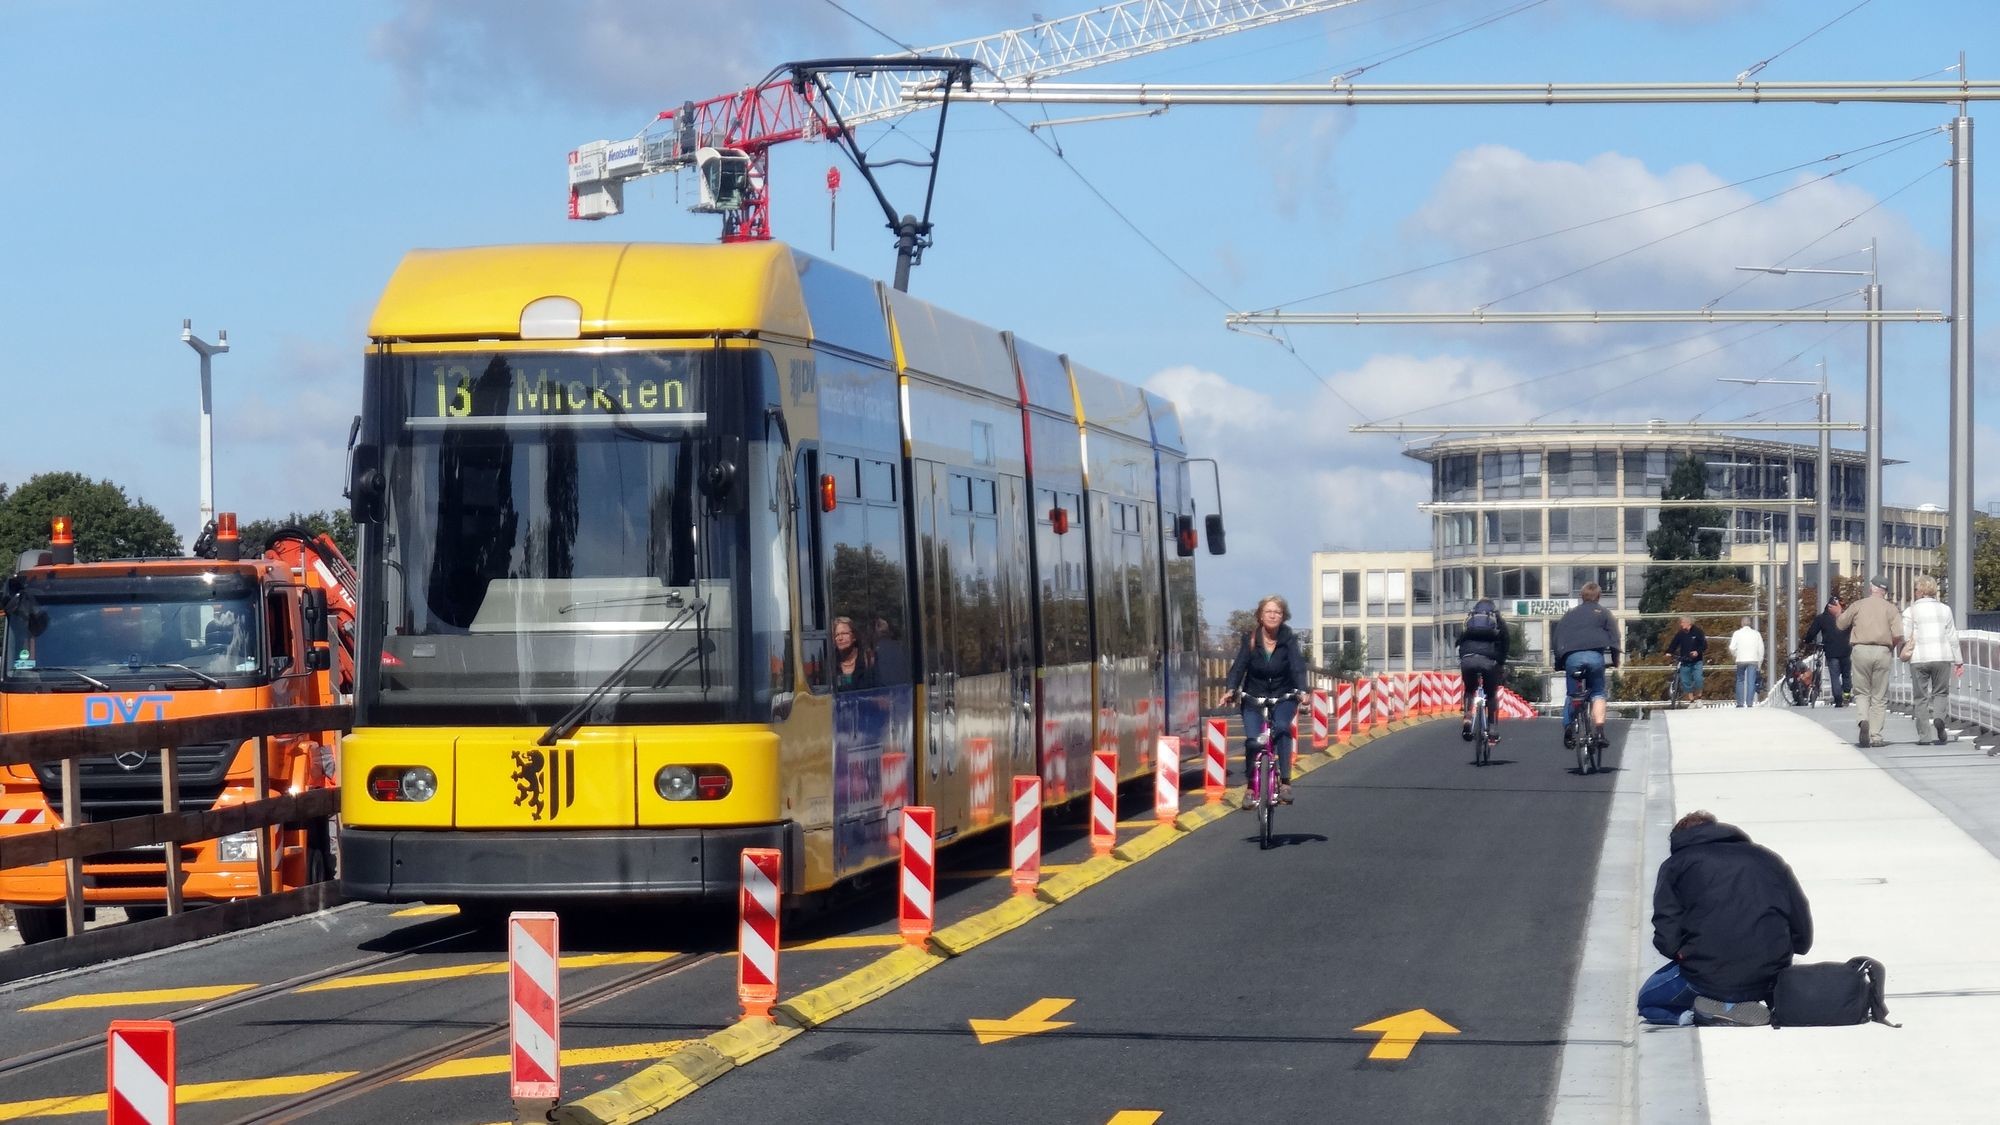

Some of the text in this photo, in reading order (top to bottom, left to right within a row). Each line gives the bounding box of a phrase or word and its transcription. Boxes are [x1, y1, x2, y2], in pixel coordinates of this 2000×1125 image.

[434, 366, 684, 417] 13 Mickten
[1531, 600, 1569, 608] DRESDNER
[1531, 607, 1567, 616] FACTORIN
[86, 694, 172, 726] DVT
